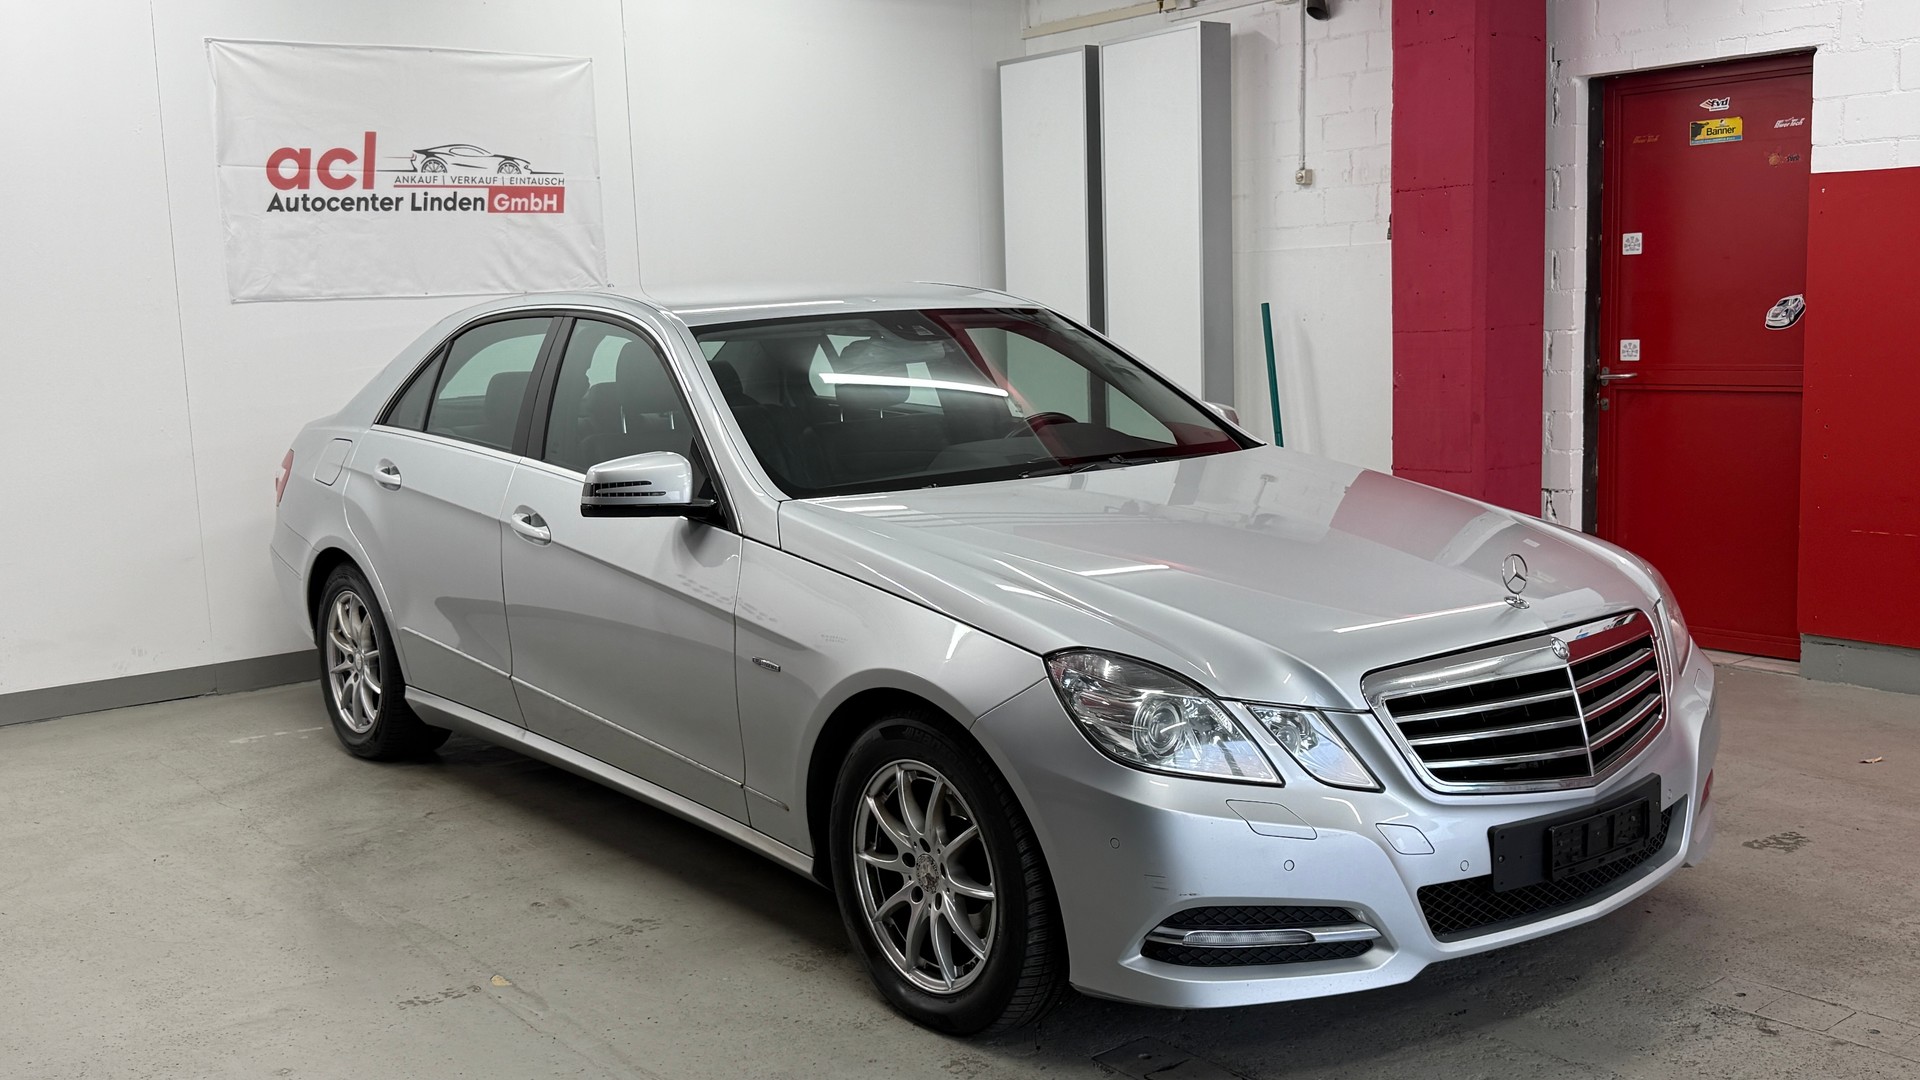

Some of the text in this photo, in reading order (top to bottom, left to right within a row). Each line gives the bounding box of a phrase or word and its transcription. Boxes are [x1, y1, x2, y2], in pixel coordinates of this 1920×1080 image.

[1706, 126, 1736, 136] Banner
[266, 131, 377, 191] acl
[394, 175, 565, 186] ANKAUF VERKAUF EINTAUSCH
[266, 191, 558, 212] Autocenter Linden GmbH
